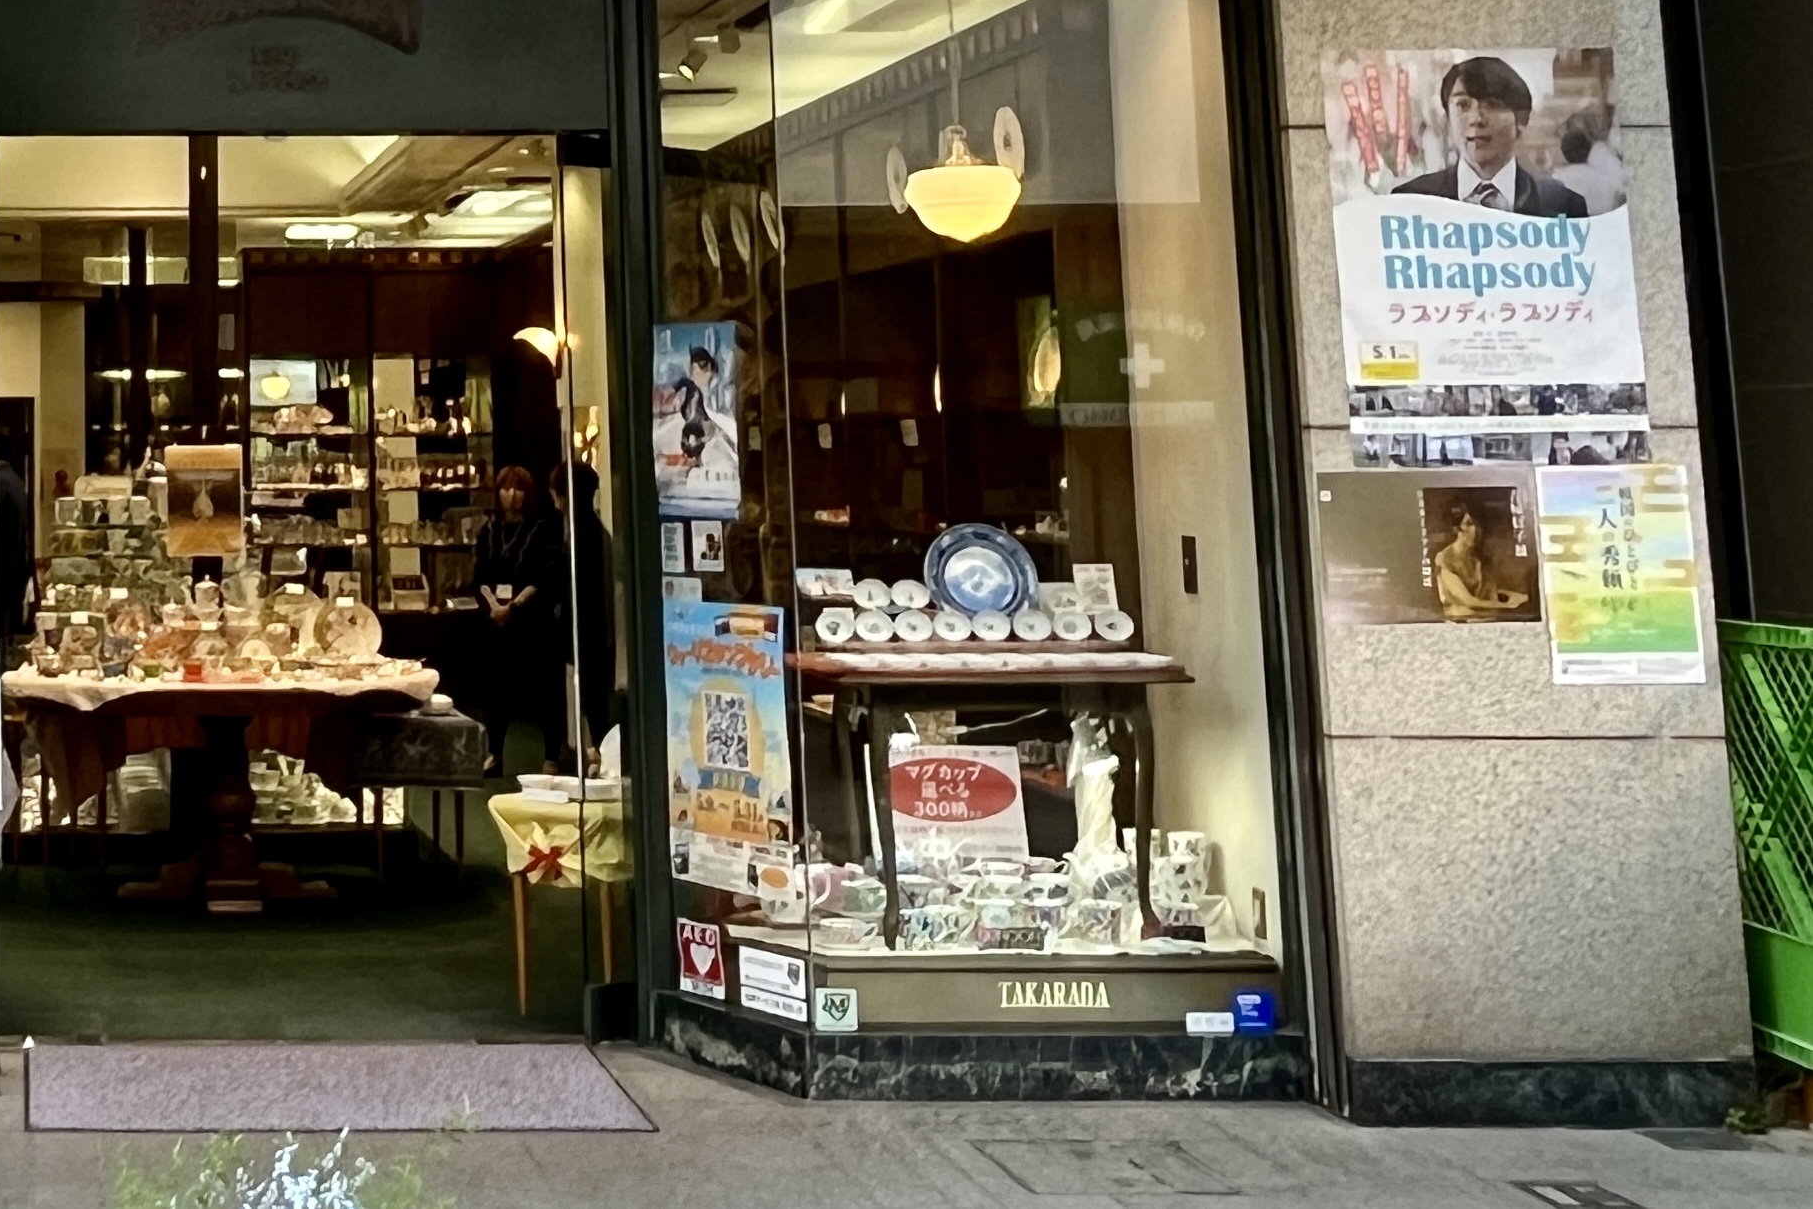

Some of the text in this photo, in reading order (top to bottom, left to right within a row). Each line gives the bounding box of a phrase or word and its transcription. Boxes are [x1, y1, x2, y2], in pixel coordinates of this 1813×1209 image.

[1380, 213, 1591, 257] Rhapsody
[1384, 253, 1596, 297] Rhapsody
[682, 924, 716, 944] AED
[998, 981, 1111, 1008] TAKARADA
